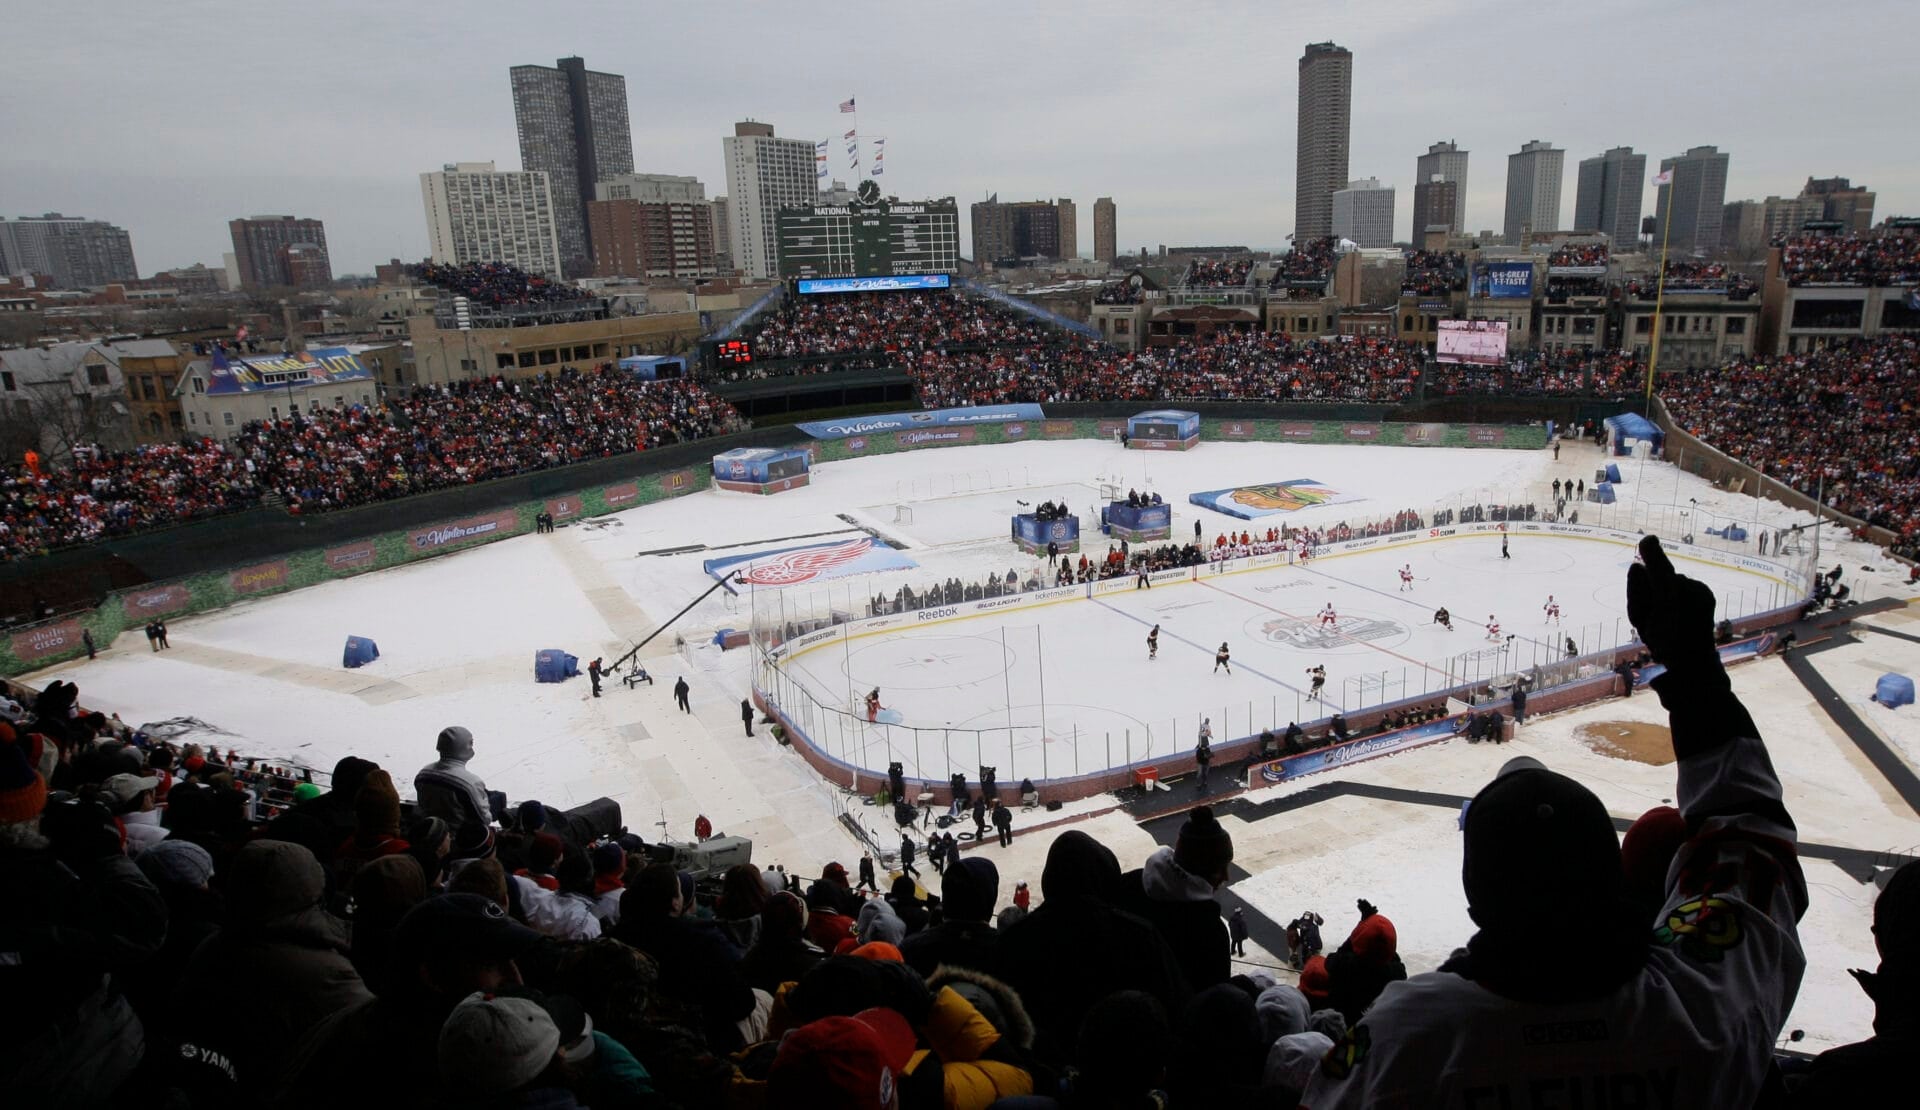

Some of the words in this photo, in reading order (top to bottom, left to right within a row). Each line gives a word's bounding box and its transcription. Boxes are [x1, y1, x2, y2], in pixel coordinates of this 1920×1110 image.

[814, 207, 852, 216] NATIONAL
[889, 205, 925, 214] AMERICAN
[1492, 270, 1530, 278] G-G-GREAT
[1494, 278, 1527, 286] T-T-TASTE
[827, 421, 902, 434] Winter
[947, 413, 1019, 422] CLASSIC
[908, 431, 935, 443] Winter
[427, 526, 465, 545] Winter
[465, 522, 497, 536] CLASSIC
[1741, 559, 1775, 573] HONDA
[1035, 587, 1077, 600] ticketmaster
[977, 601, 996, 609] BUD
[997, 597, 1023, 606] LIGHT
[918, 606, 958, 621] Reebok
[34, 637, 64, 650] CISCO
[1335, 740, 1372, 762] Winter
[1371, 737, 1401, 750] CLASSIC
